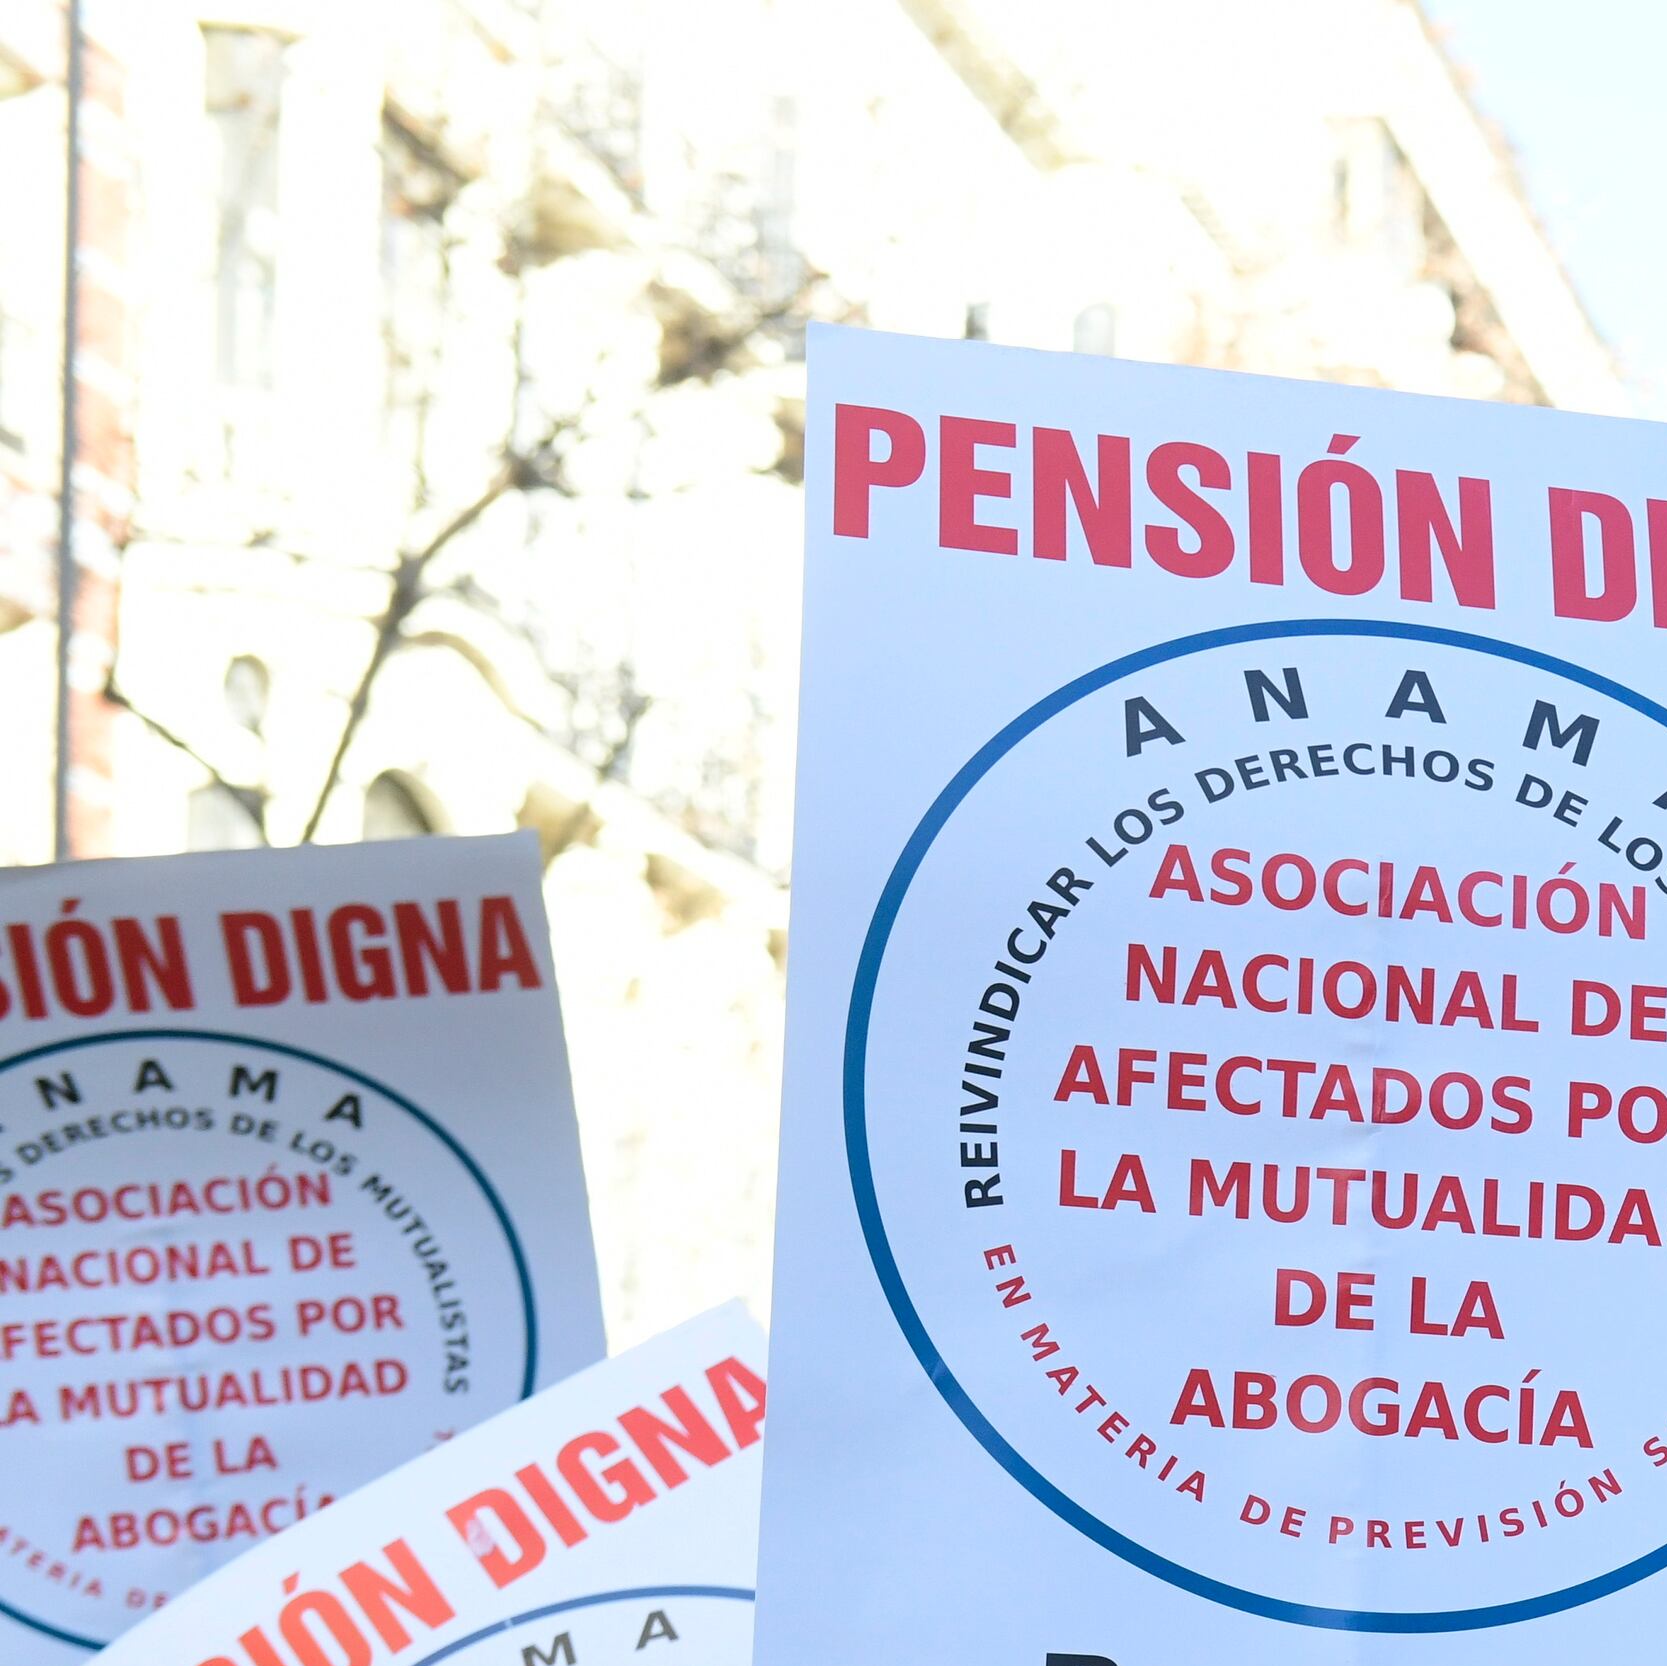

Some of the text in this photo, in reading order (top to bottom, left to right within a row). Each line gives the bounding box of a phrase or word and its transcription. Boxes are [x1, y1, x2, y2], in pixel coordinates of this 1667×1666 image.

[834, 404, 1496, 610] PENSIÓN
[1149, 844, 1647, 940] ASOCIACIÓN
[0, 897, 540, 1020] IÓN DIGNA
[960, 867, 1094, 1208] REIVINDICAR
[1085, 788, 1184, 867] LOS
[1194, 743, 1494, 803] DERECHOS
[1515, 774, 1589, 827] DE
[1126, 944, 1540, 1033] NACIONAL
[0, 1059, 376, 1129] NAMA
[1055, 1045, 1533, 1134] AFECTADOS
[4, 1175, 330, 1227] ASOCIACIÓN
[1058, 1149, 1157, 1214] LA
[0, 1232, 355, 1293] NACIONAL DE
[16, 1108, 469, 1393] DERECHOS DE LOS MUTUALISTAS
[0, 1294, 404, 1360] FECTADOS POR
[1274, 1268, 1505, 1340] DE LA
[60, 1360, 408, 1419] MUTUALIDAD
[983, 1244, 1032, 1309] EN
[1021, 1323, 1206, 1503] MATERIA
[1240, 1494, 1307, 1537] DE
[1329, 1469, 1623, 1549] PREVISIÓN
[1171, 1368, 1593, 1449] ABOGACÍA
[126, 1435, 278, 1483] DE LA
[446, 1357, 767, 1588] DIGNA
